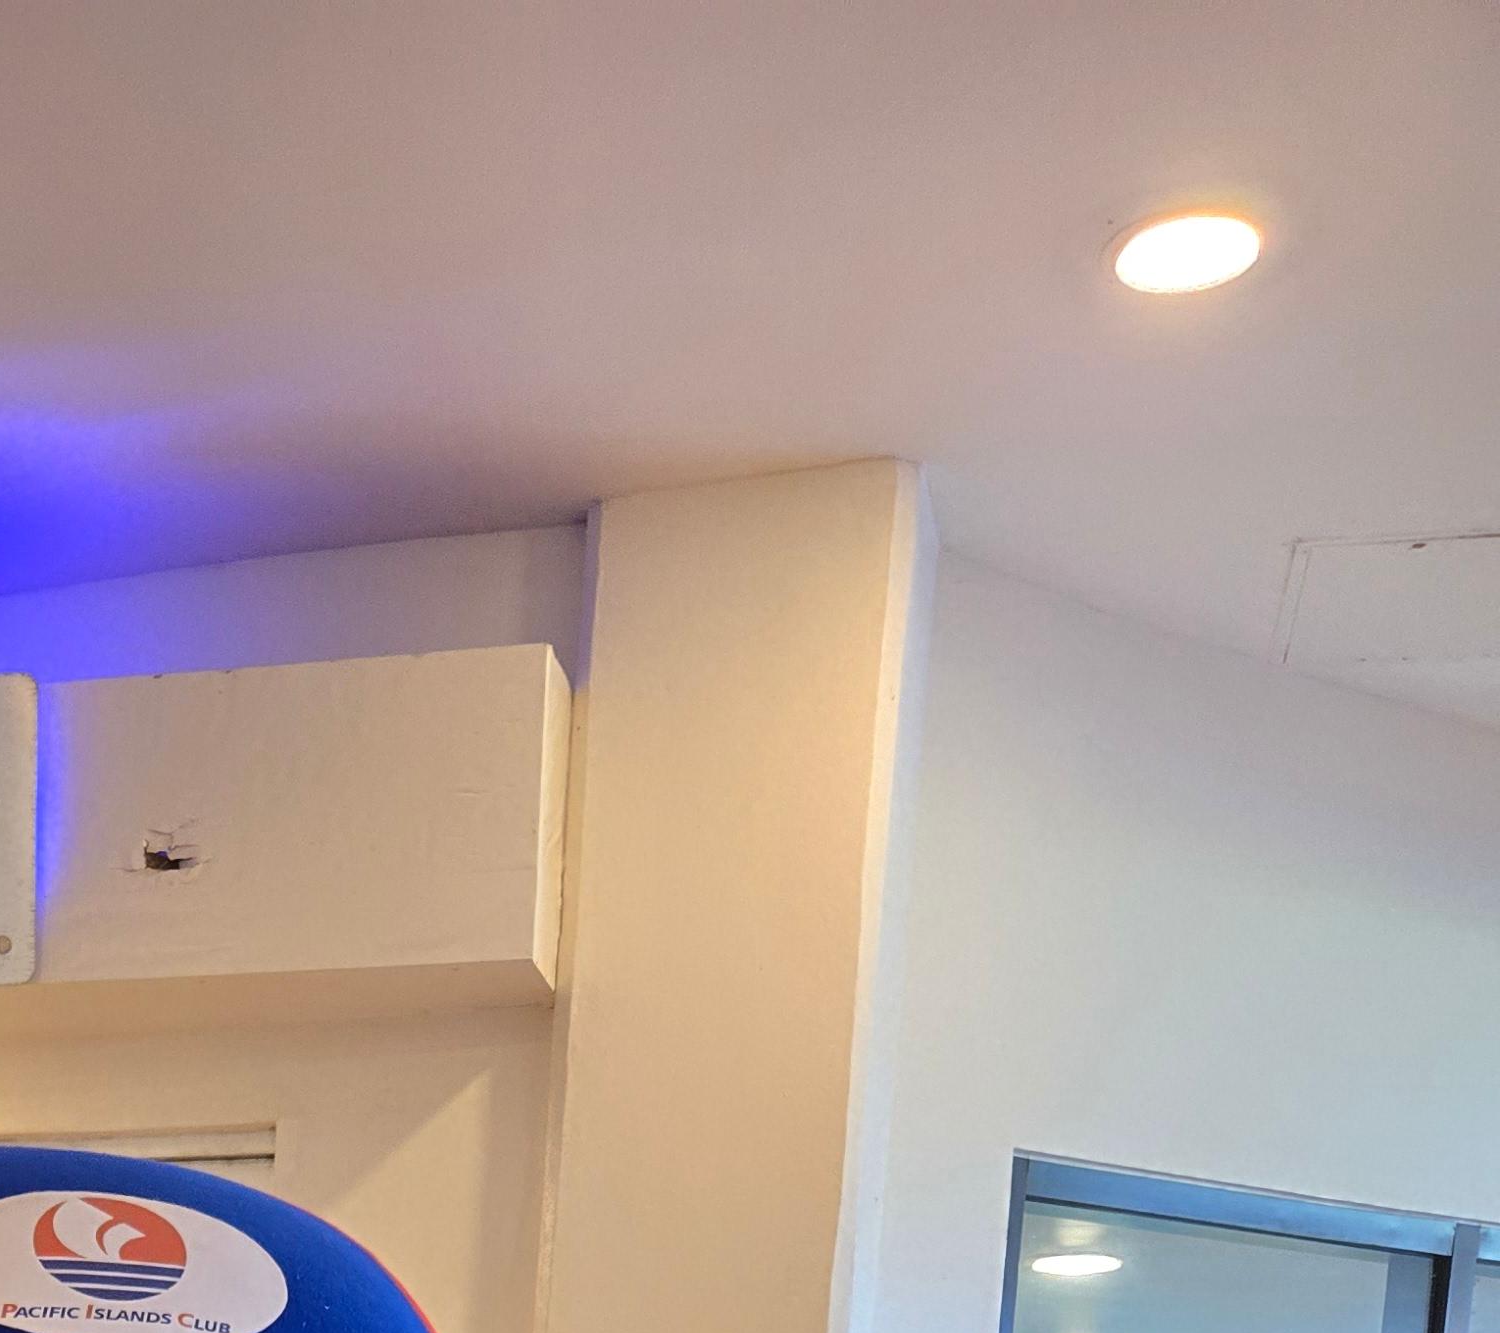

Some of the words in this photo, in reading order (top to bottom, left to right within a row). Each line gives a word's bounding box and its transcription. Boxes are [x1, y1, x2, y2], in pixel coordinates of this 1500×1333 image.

[0, 1303, 80, 1319] PACIFIC
[85, 1304, 172, 1325] ISLANDS
[177, 1313, 231, 1333] CLUB
